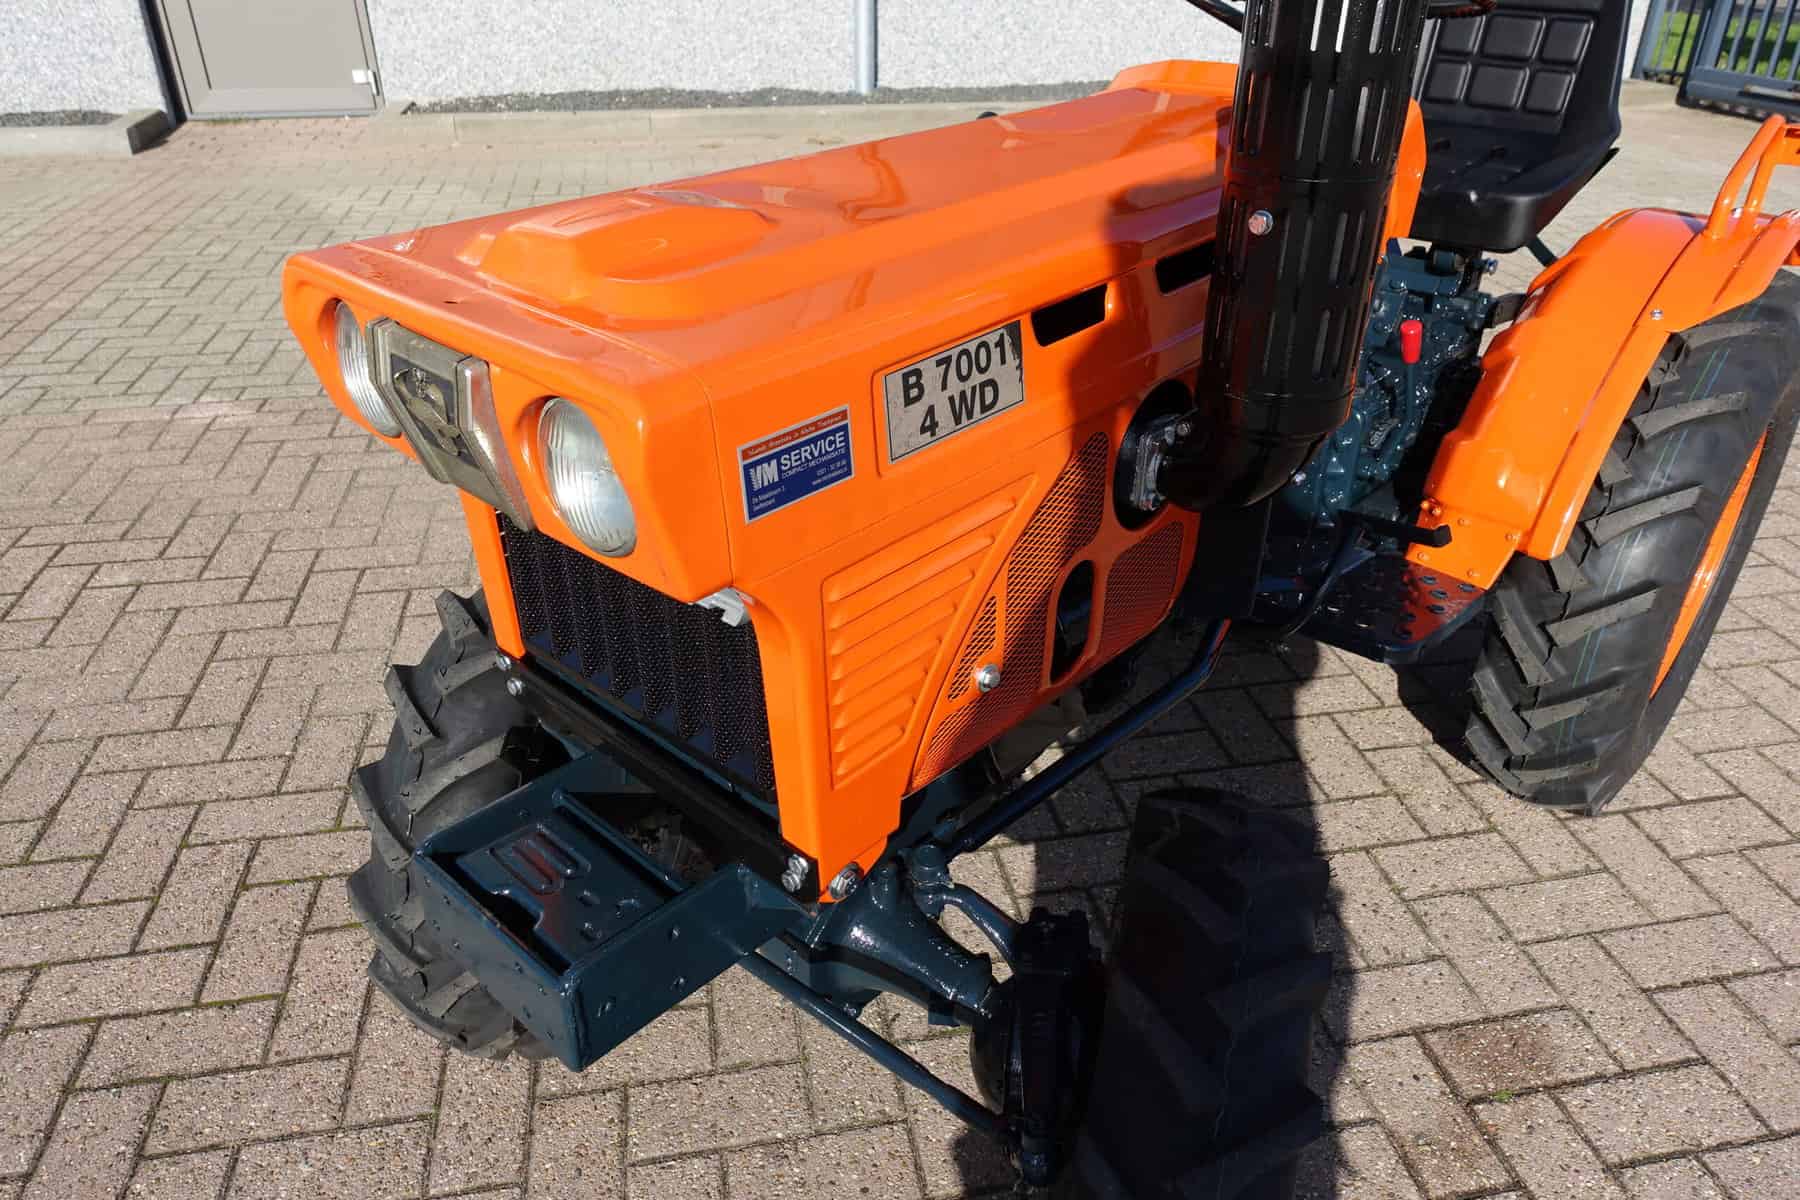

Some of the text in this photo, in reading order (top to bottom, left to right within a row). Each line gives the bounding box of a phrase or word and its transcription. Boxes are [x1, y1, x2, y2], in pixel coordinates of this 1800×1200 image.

[902, 333, 1006, 408] B 7001
[920, 378, 999, 437] 4 WD
[780, 431, 845, 471] SERVICE
